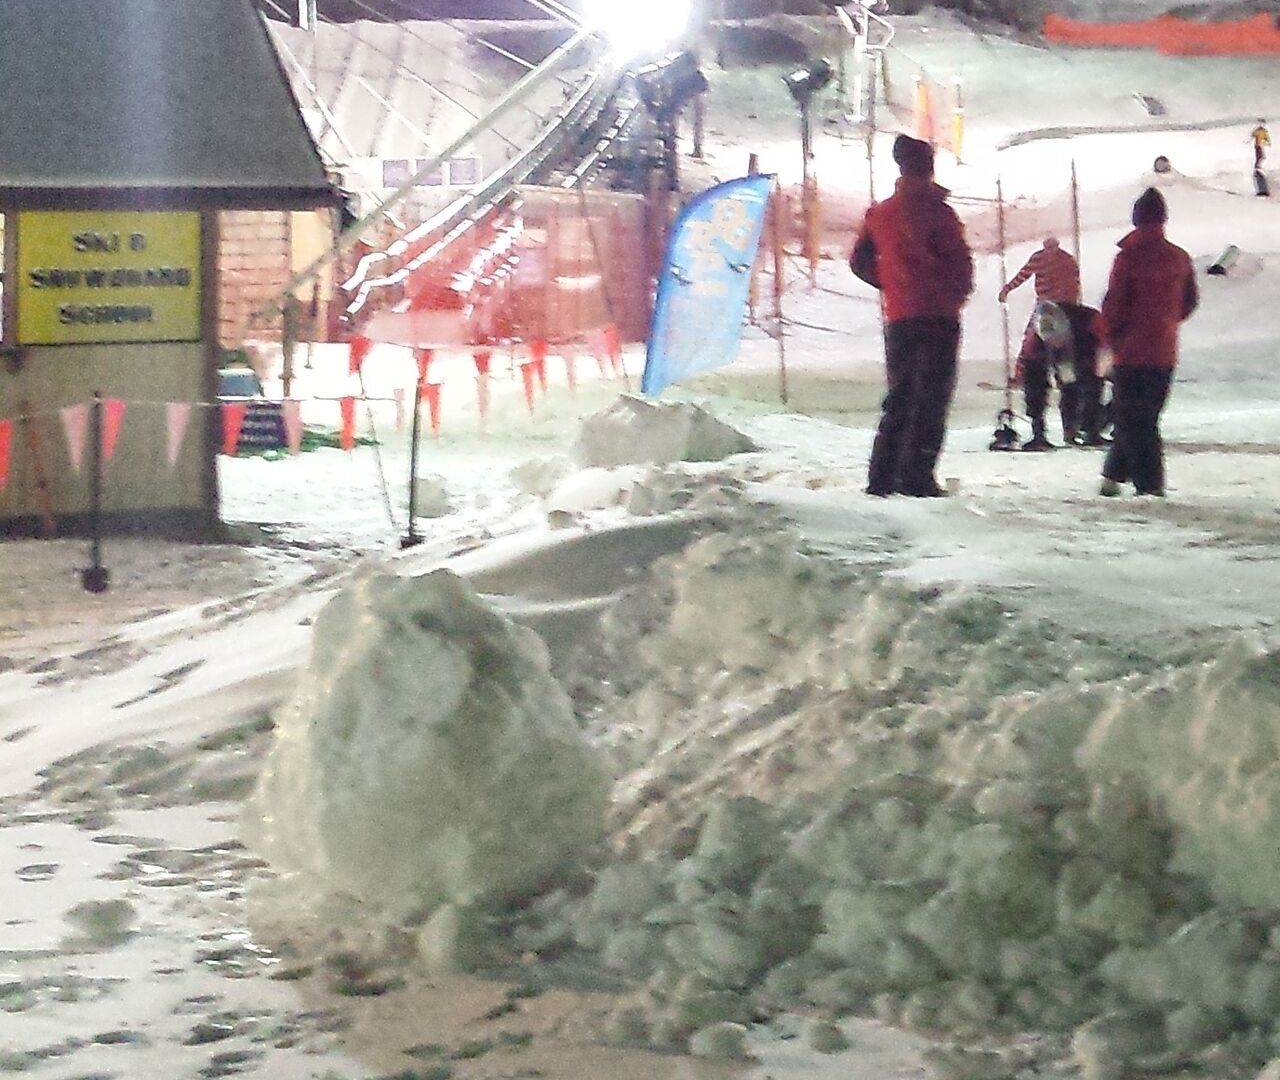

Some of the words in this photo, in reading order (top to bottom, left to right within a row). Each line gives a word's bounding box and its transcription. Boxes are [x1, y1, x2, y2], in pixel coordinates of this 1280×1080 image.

[73, 231, 120, 253] SKI
[28, 268, 191, 288] SNOWBOARD
[59, 303, 153, 324] SCHOOL
